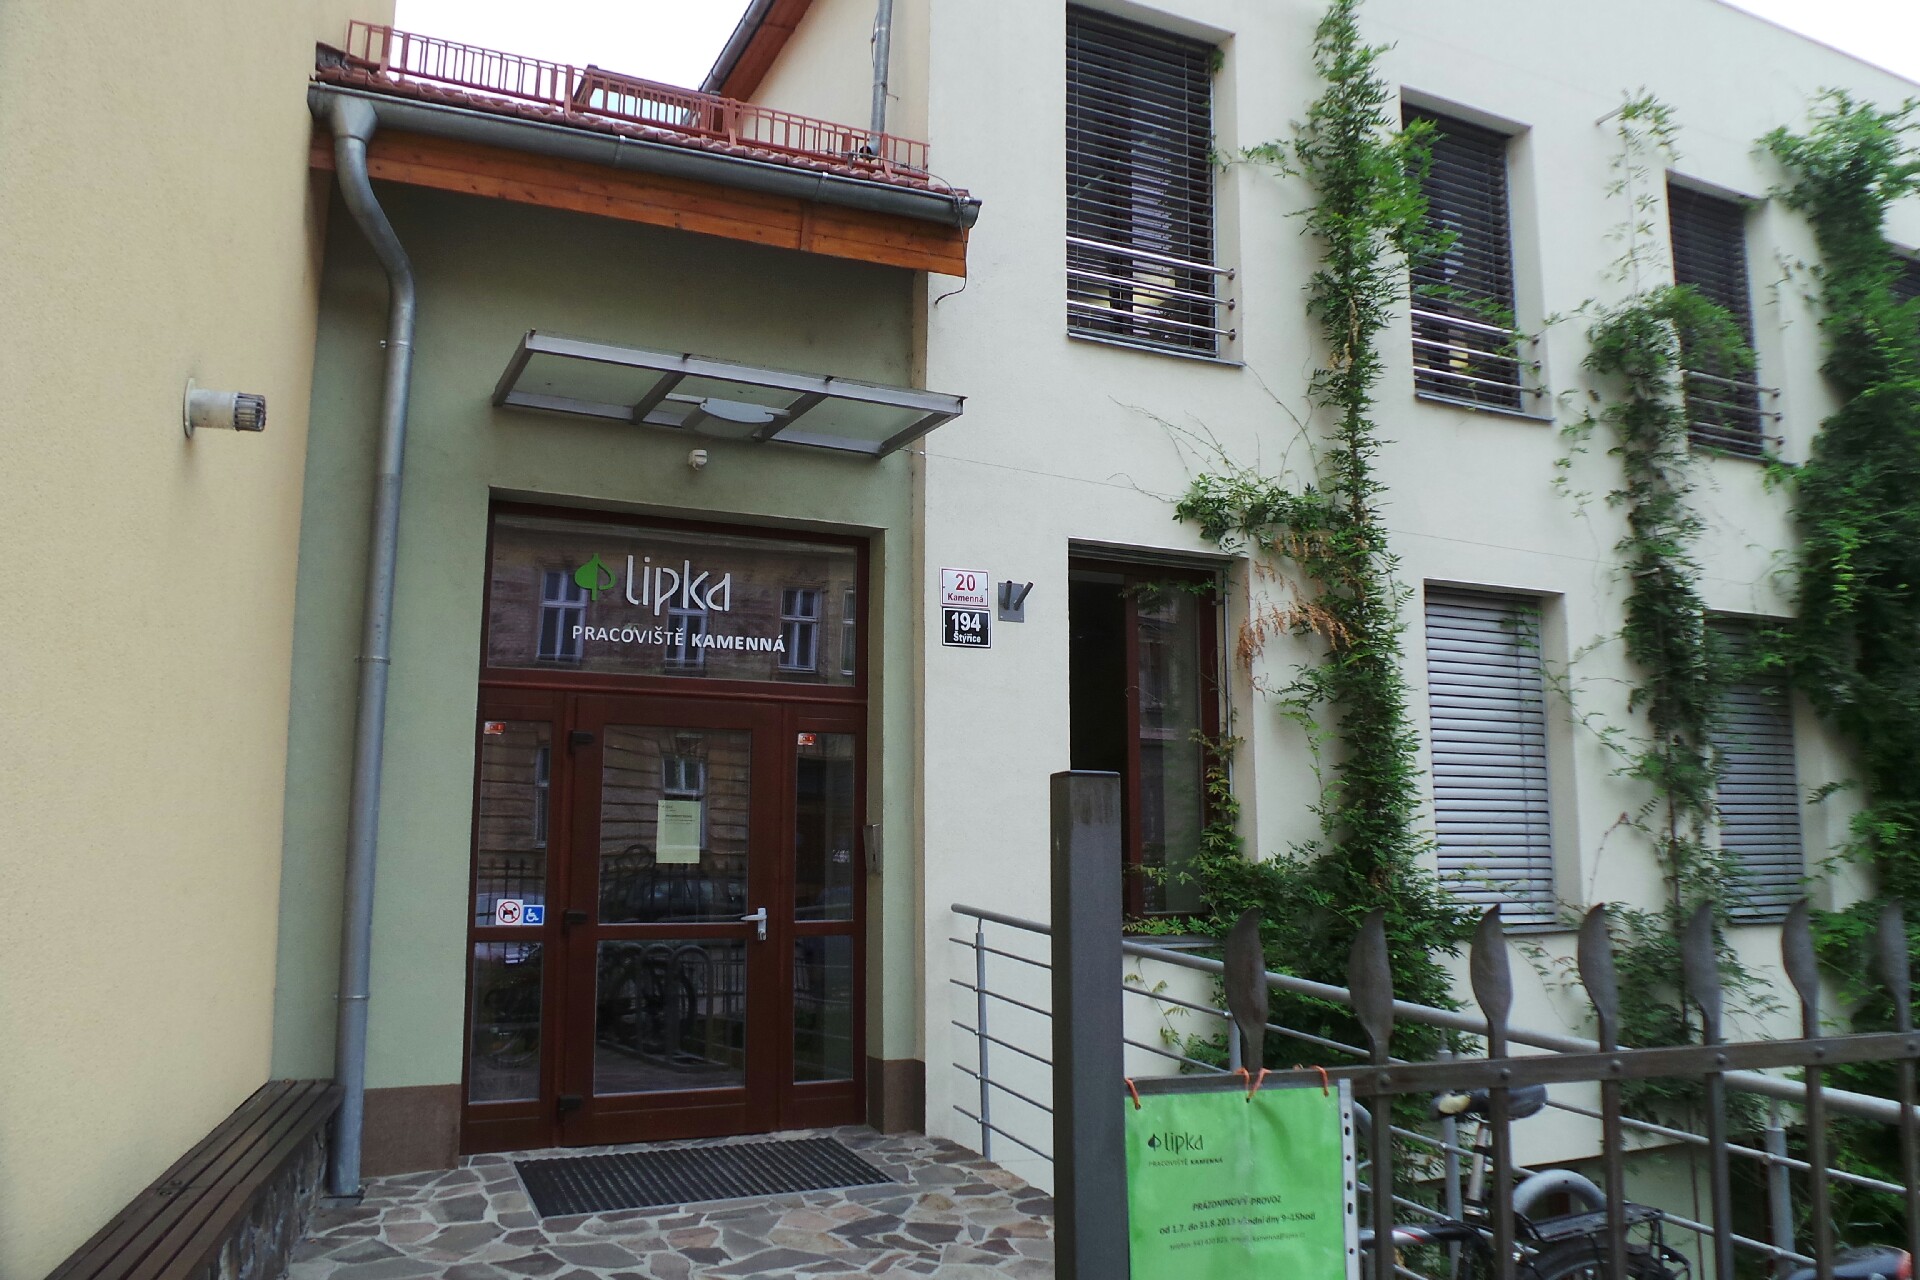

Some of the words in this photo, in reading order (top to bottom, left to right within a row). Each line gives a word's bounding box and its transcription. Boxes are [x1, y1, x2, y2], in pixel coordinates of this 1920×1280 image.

[626, 555, 731, 616] lipka
[955, 573, 976, 591] 20
[947, 593, 984, 603] Kamenná
[951, 612, 981, 632] 194
[572, 625, 684, 647] PRACOVIŠTĚ
[691, 634, 786, 653] KAMENNÁ
[953, 630, 981, 643] Štýřice
[1164, 1131, 1204, 1155] lipka
[1250, 1195, 1282, 1205] PROVOZ
[1160, 1225, 1170, 1234] od
[1188, 1222, 1199, 1231] do
[1266, 1215, 1279, 1224] dny
